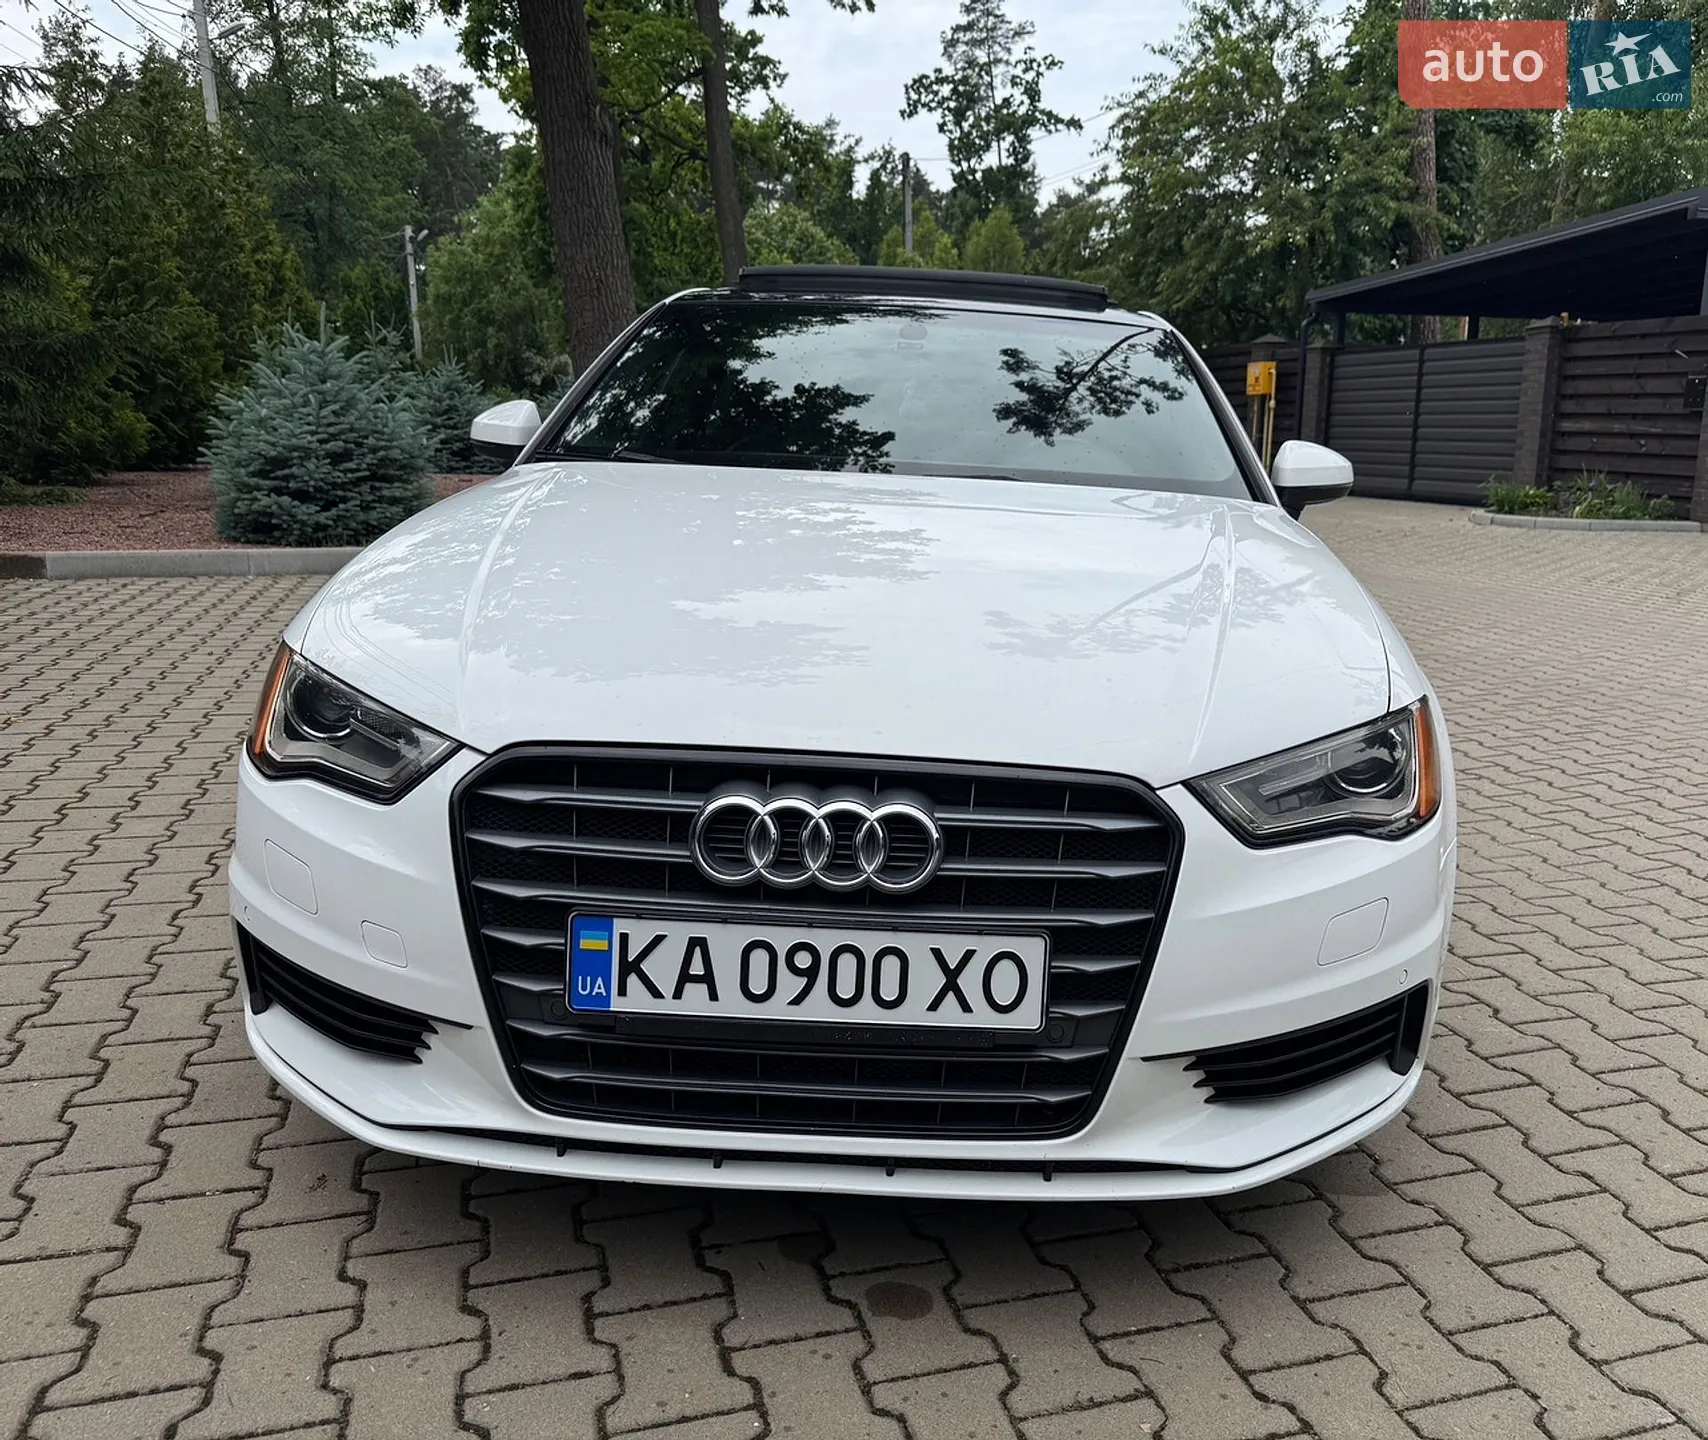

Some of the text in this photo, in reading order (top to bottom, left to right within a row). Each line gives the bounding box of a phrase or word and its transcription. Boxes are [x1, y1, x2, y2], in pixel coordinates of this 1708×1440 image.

[577, 976, 607, 997] UA
[617, 931, 1028, 1014] KA 0900 XO
